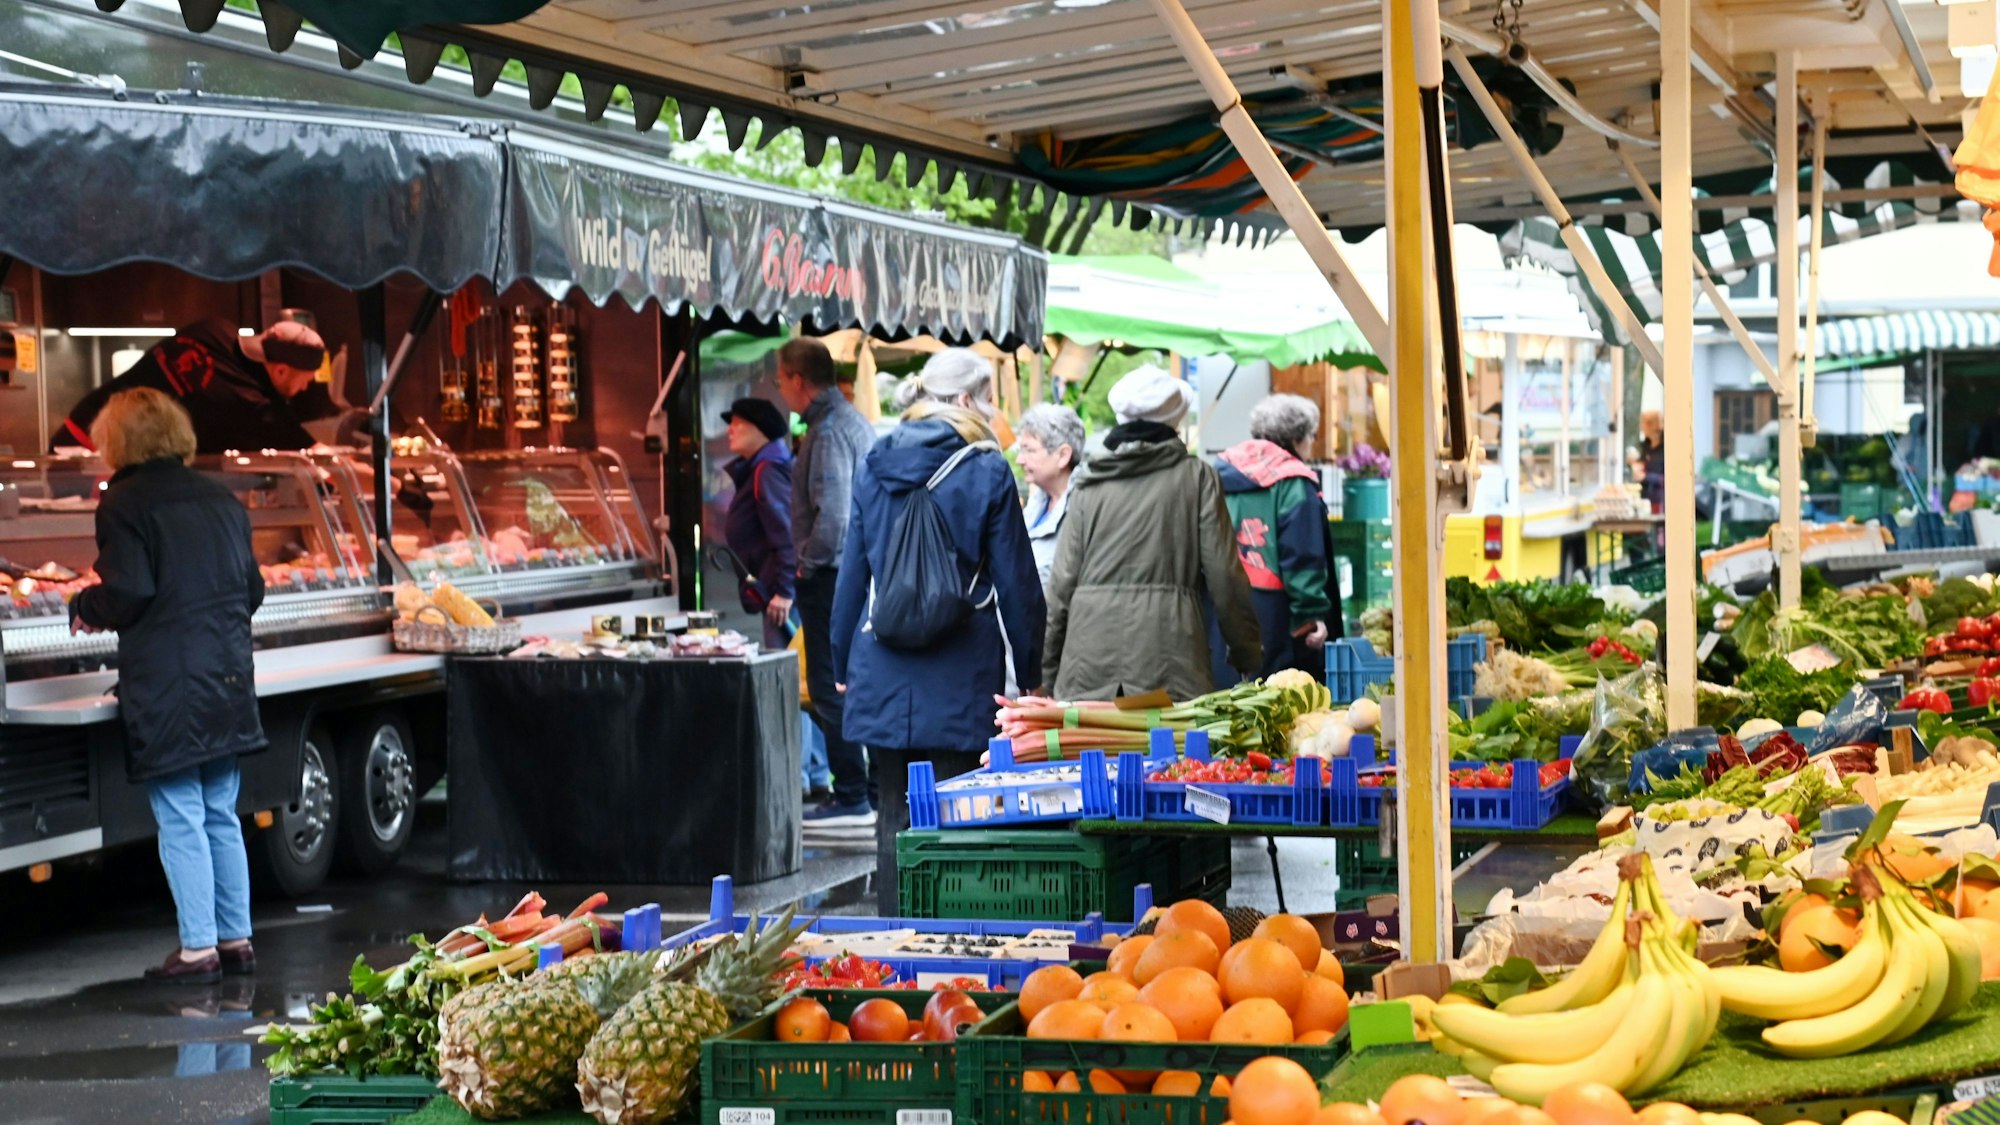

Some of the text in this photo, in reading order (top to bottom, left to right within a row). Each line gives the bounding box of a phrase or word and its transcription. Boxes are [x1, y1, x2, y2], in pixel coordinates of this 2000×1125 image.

[578, 217, 713, 293] Wild u. Geflügel
[756, 1112, 771, 1121] 104
